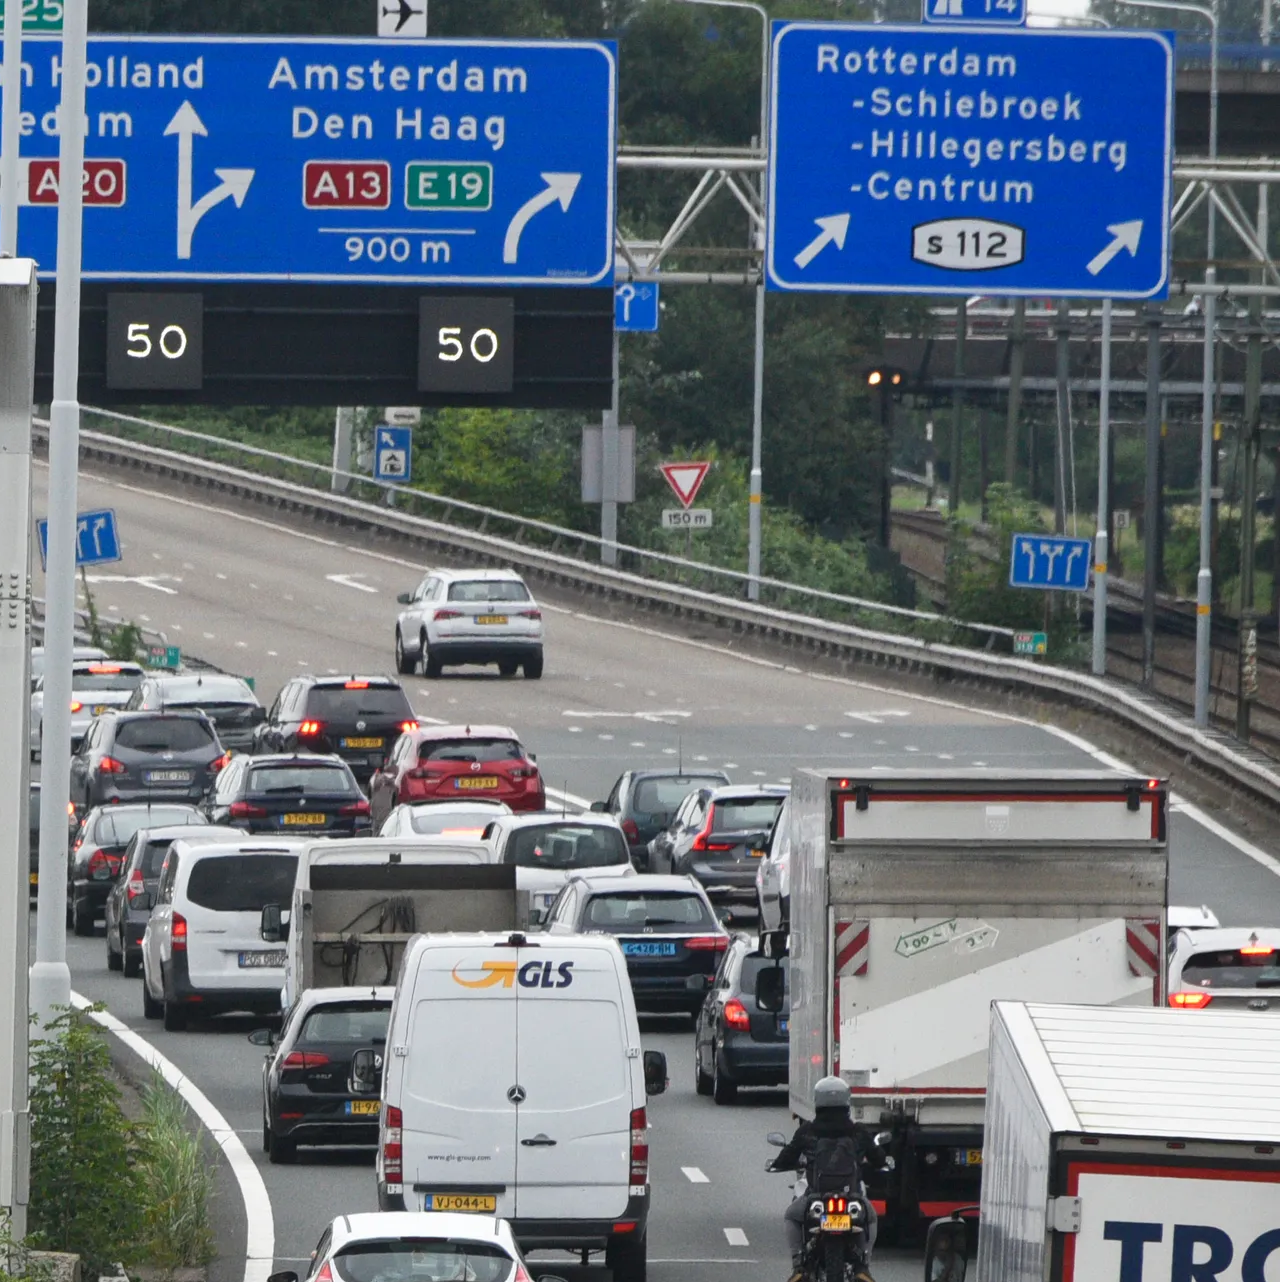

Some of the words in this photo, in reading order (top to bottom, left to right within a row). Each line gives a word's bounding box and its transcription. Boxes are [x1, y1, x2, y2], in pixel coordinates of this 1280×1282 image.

[268, 56, 528, 93] Amsterdam
[816, 44, 1017, 77] Rotterdam
[292, 106, 373, 139] Den
[395, 107, 506, 151] Haag
[312, 170, 382, 200] A13
[418, 171, 484, 200] E19
[344, 236, 410, 262] 900
[421, 240, 451, 263] m
[956, 230, 1008, 258] 112
[126, 323, 188, 360] 50
[438, 327, 499, 363] 50
[666, 513, 689, 526] 150
[517, 960, 574, 990] GLS
[427, 1153, 492, 1163] www.gls-group.com
[436, 1197, 490, 1209] VJ-044-L
